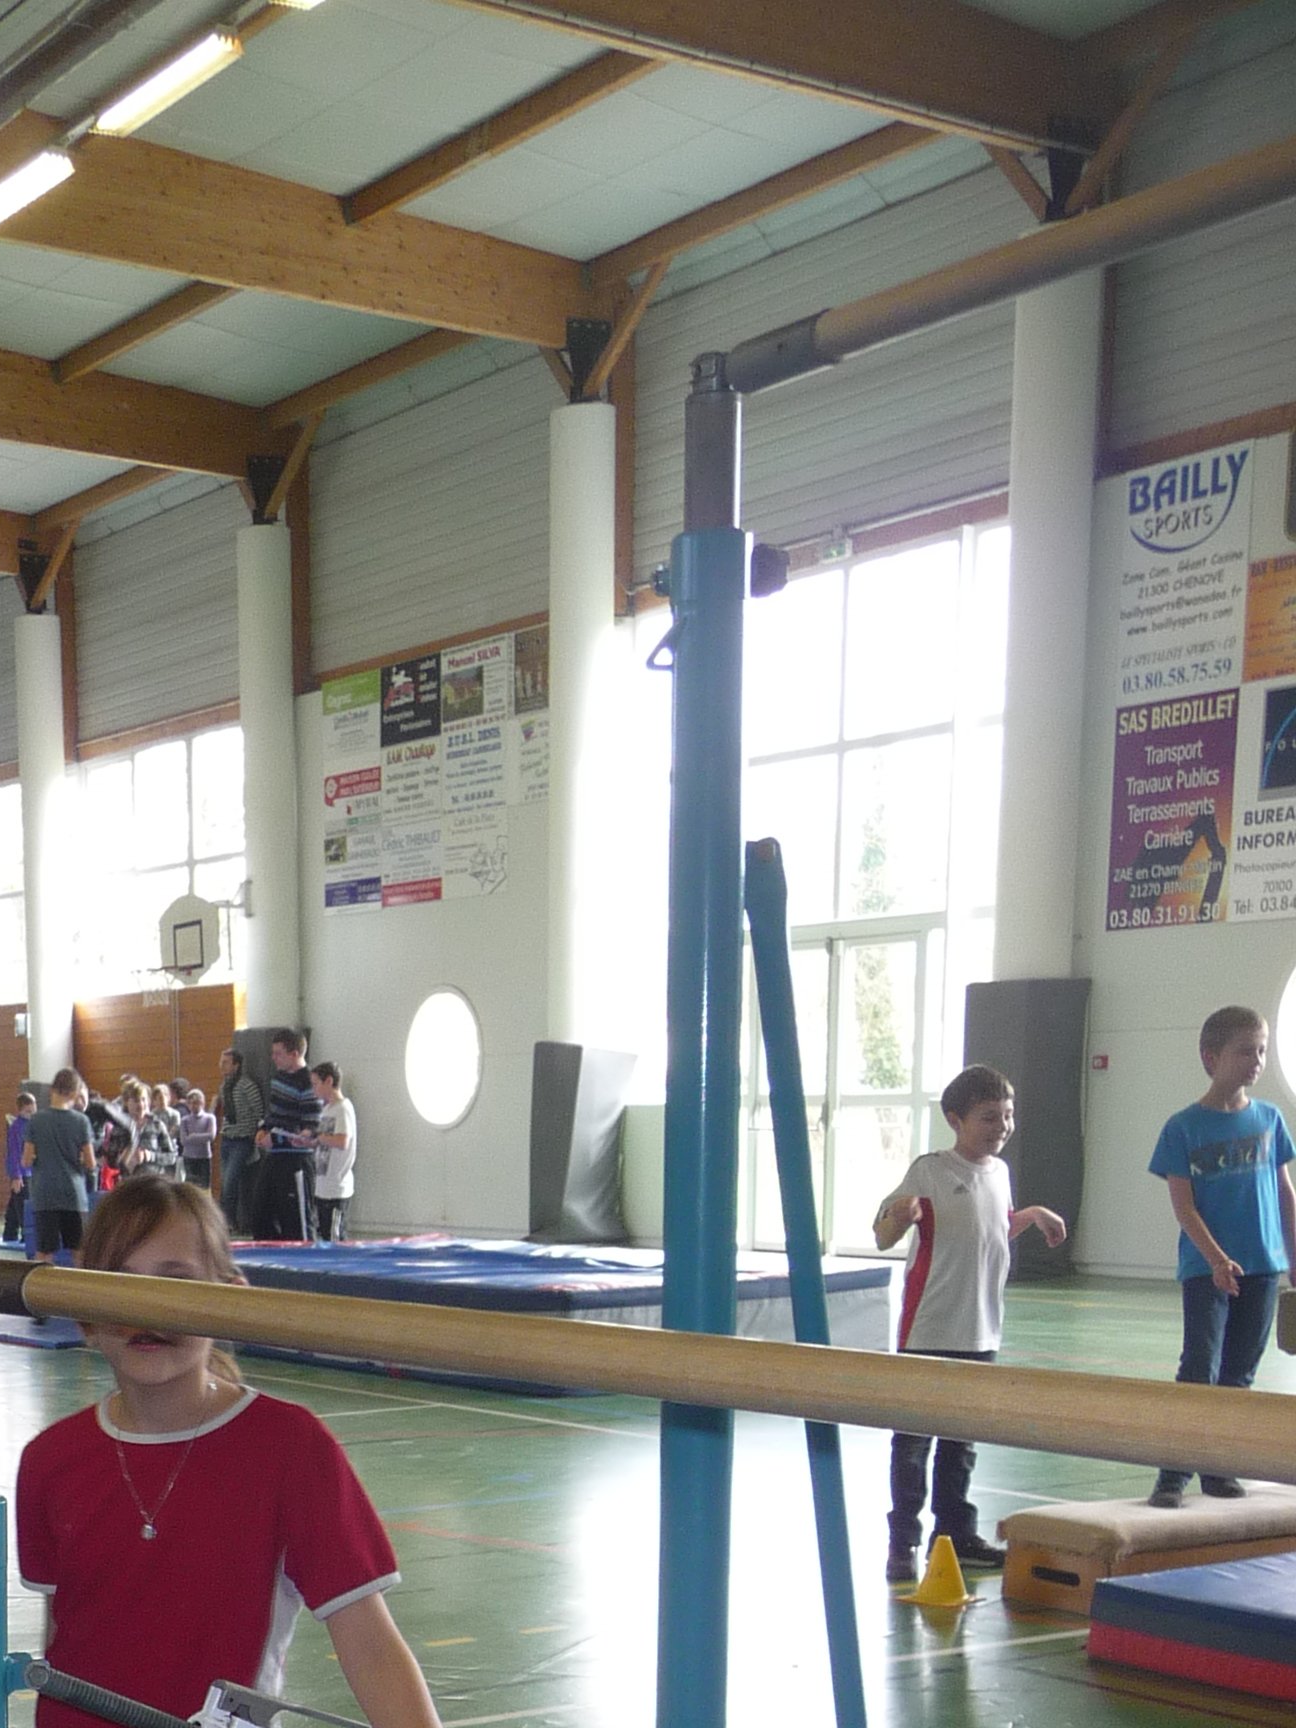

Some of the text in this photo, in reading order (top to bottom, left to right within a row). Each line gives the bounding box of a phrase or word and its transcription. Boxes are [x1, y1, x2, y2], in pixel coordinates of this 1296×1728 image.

[1128, 448, 1250, 517] BAILLY
[1143, 504, 1213, 539] SPORTS
[1138, 581, 1169, 599] 21300
[477, 645, 501, 663] SILVA
[1122, 658, 1232, 694] 03.80.58.75.59
[1118, 694, 1236, 736] SAS BREDILLET
[1144, 739, 1204, 767] Transport
[1125, 767, 1220, 797] Travaux Publics
[1127, 796, 1216, 824] Terrassements
[1144, 824, 1194, 850] Carrière
[1113, 868, 1133, 883] ZAE
[1135, 867, 1149, 880] en
[1129, 882, 1161, 899] 21270
[1109, 902, 1222, 929] 03.80.31.91.30
